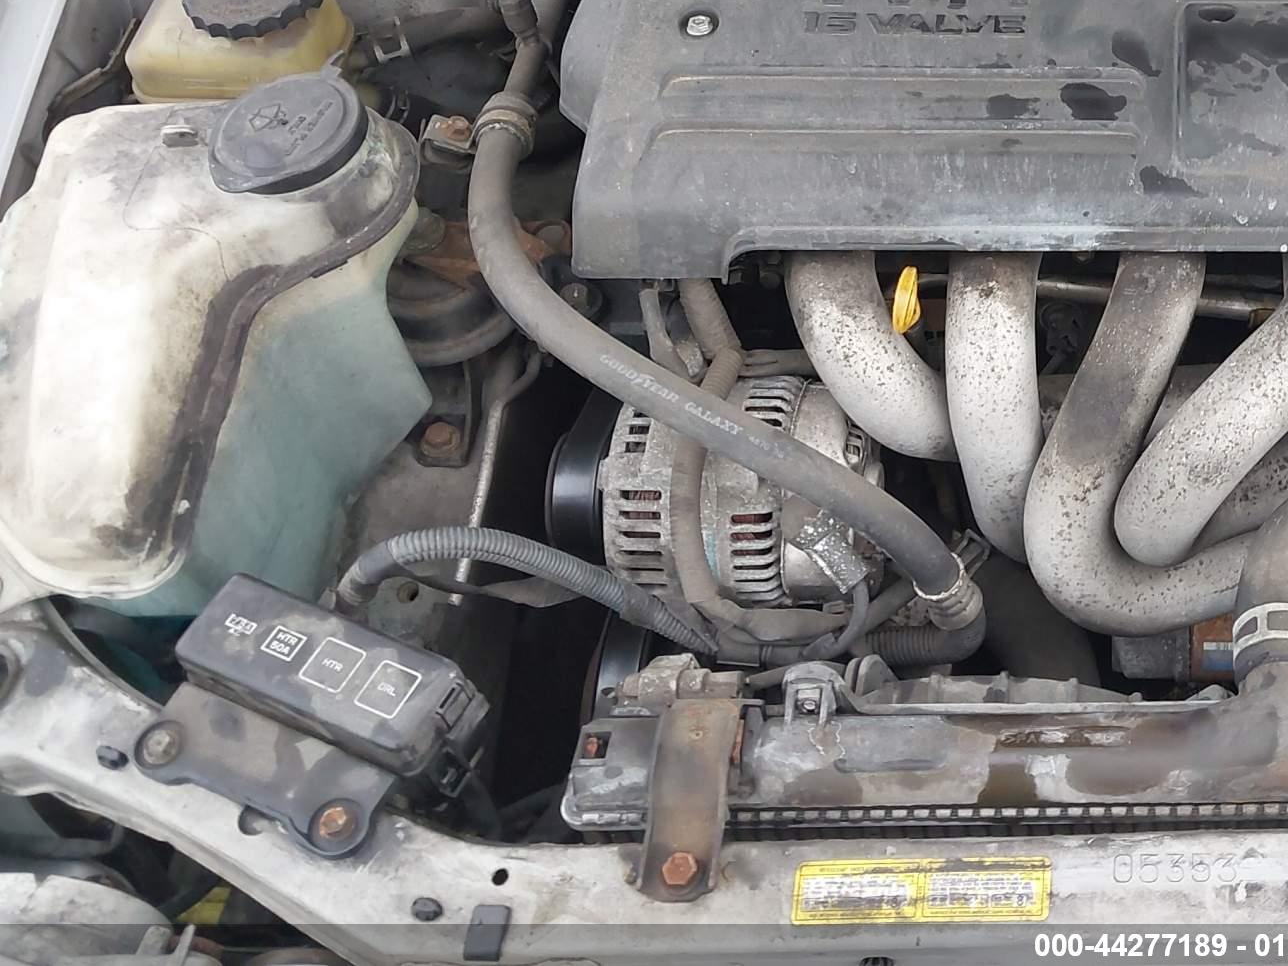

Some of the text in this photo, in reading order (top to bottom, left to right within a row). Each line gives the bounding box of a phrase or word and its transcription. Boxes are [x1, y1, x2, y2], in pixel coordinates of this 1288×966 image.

[803, 11, 1026, 35] 16 VALVE
[600, 354, 680, 403] GOODYEAR
[684, 401, 744, 435] GALAXY
[276, 631, 298, 645] HTR
[270, 641, 290, 655] 50A
[322, 657, 343, 672] HTR
